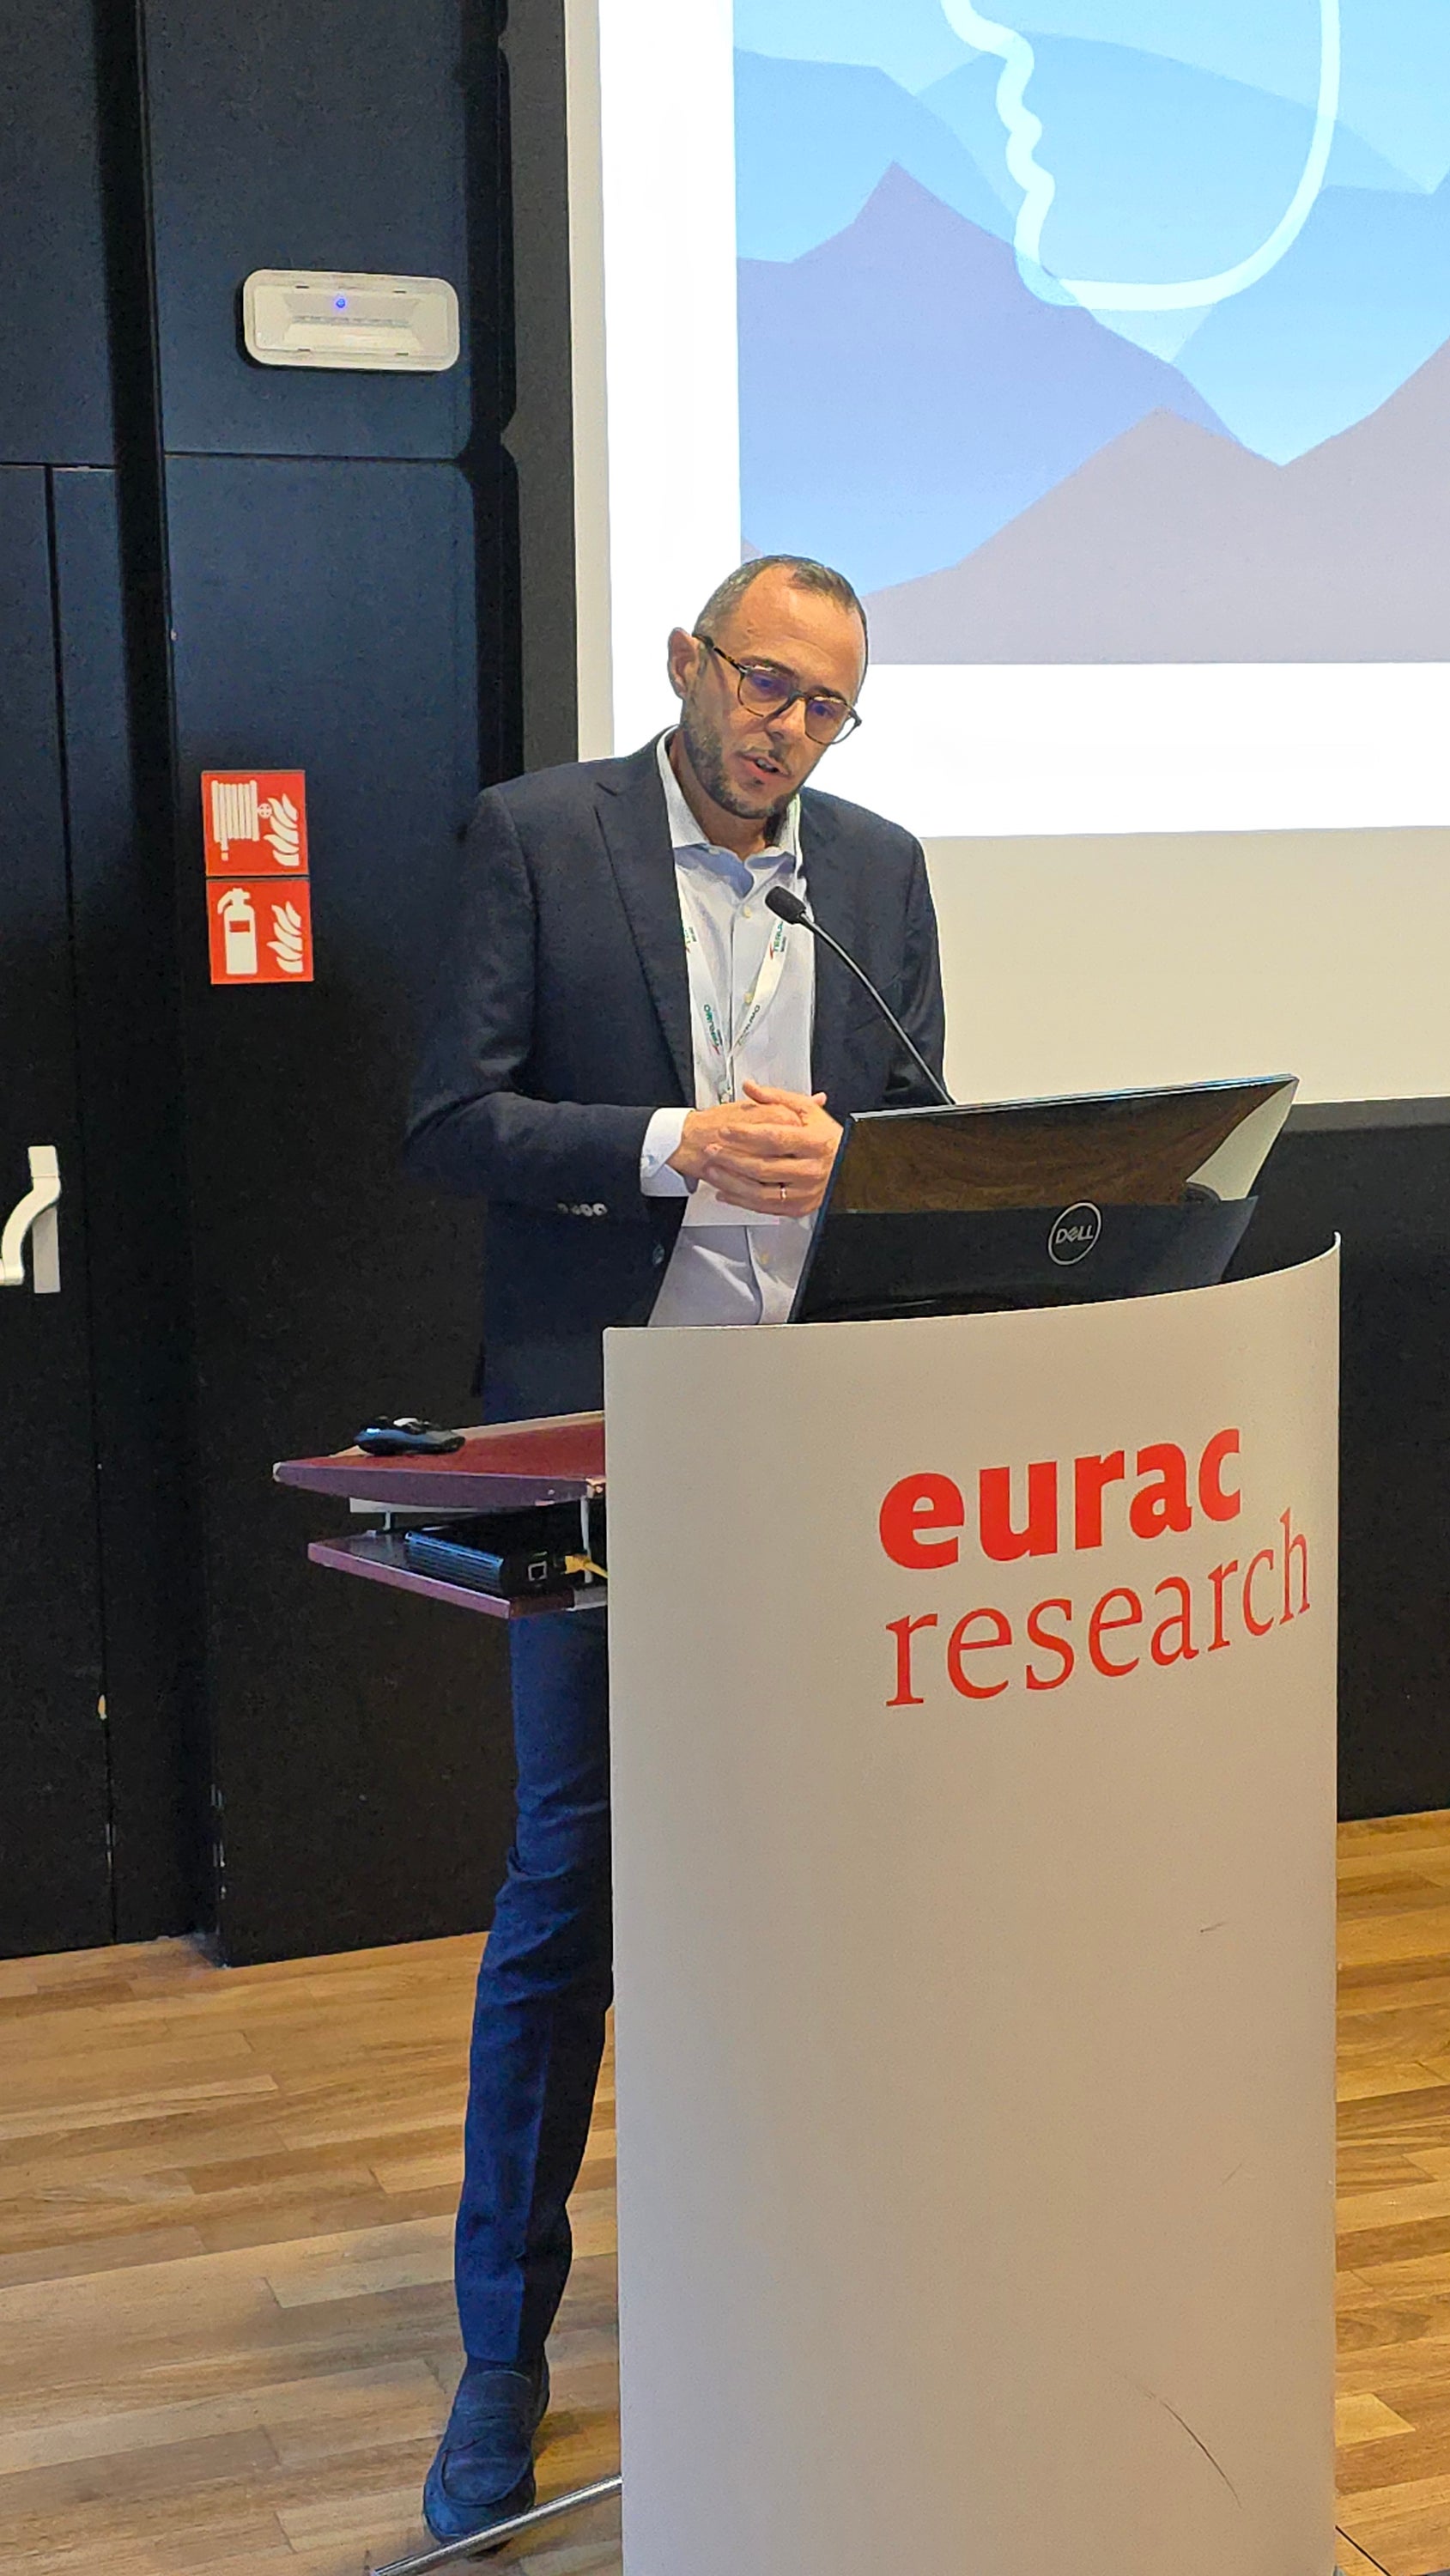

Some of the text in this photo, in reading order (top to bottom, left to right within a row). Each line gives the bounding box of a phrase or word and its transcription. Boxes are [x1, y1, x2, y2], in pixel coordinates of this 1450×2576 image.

[1055, 1224, 1094, 1244] DELL
[879, 1427, 1241, 1570] eurac
[885, 1507, 1311, 1707] research
